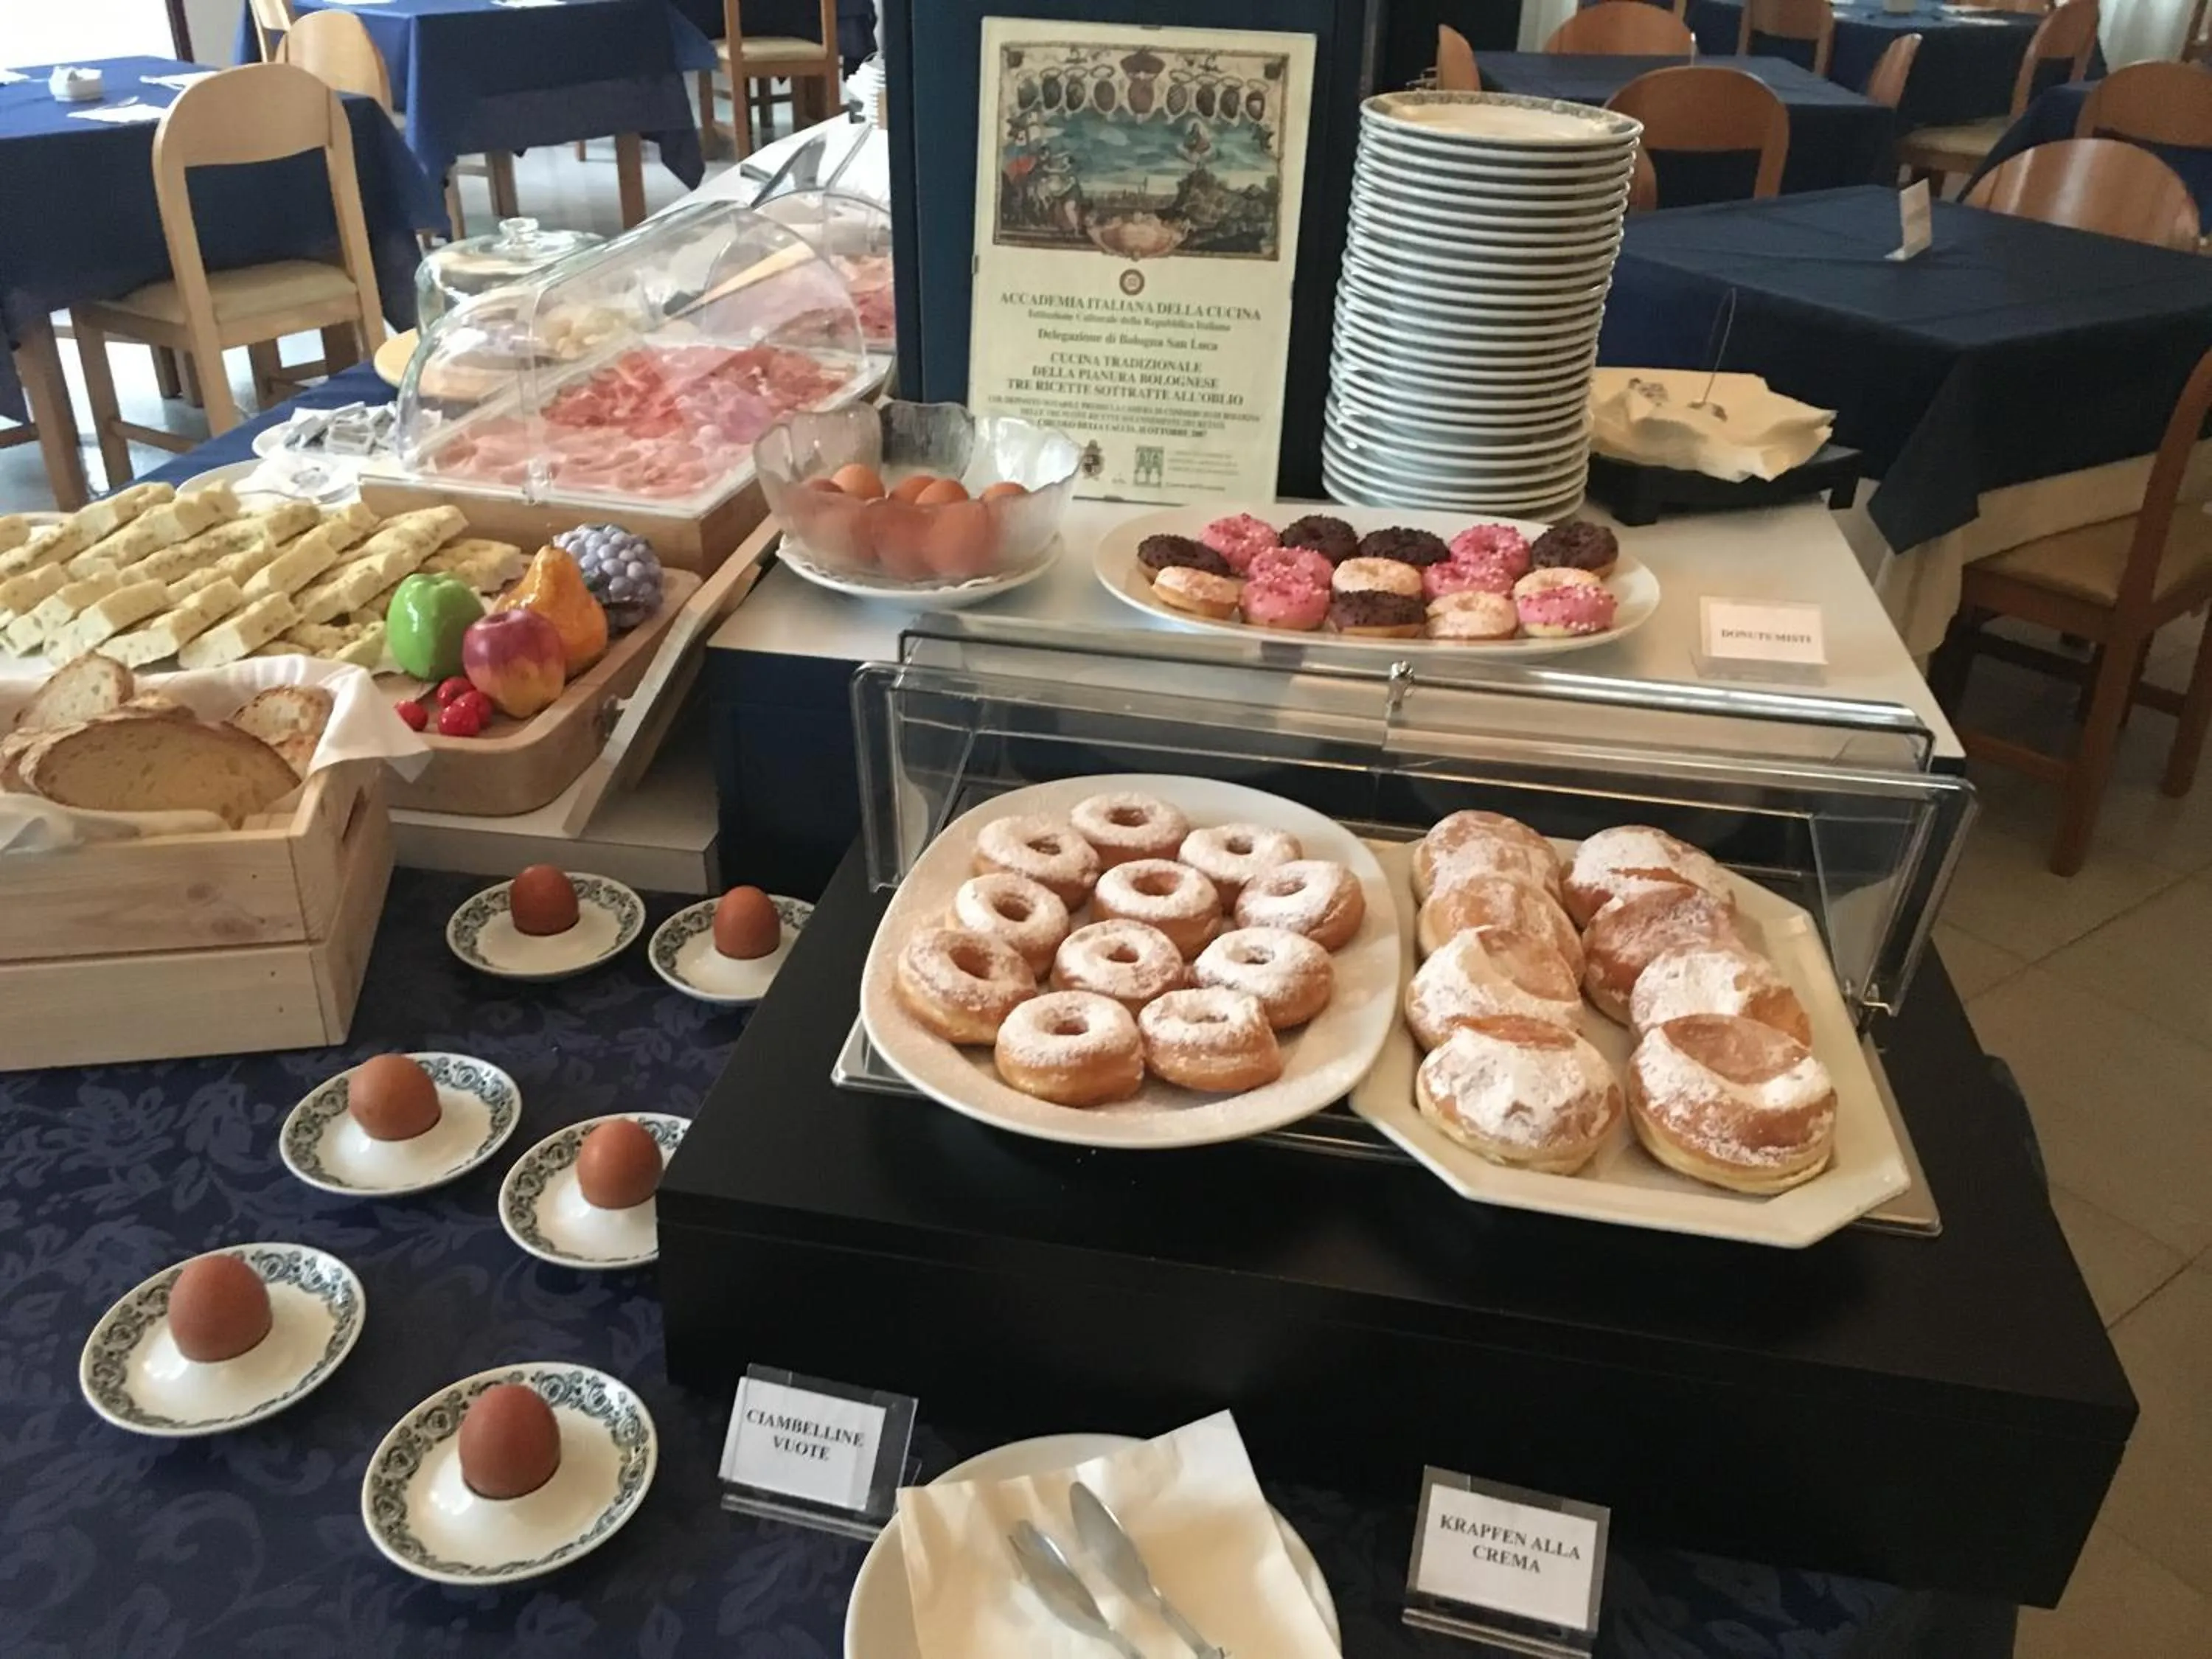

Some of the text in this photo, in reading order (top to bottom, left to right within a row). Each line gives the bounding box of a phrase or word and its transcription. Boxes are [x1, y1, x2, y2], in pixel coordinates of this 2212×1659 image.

[1000, 293, 1262, 321] ACCADEMIA ITALIANA DELLA CUCINA
[1037, 328, 1219, 351] Delegazione di Bologna San Luca
[1050, 352, 1203, 373] CUCINA TRADIZIONALE
[1006, 378, 1032, 389] TRE
[1035, 380, 1090, 394] RICETTE
[1093, 384, 1168, 401] SOTTRATTE
[1032, 365, 1219, 389] DELLA PIANURA BOLOGNESE
[745, 1408, 866, 1448] CIAMBELLINE
[773, 1434, 831, 1462] VUOTE
[1439, 1513, 1581, 1561] KRAPFEN ALLA
[1472, 1544, 1541, 1574] CREMA
